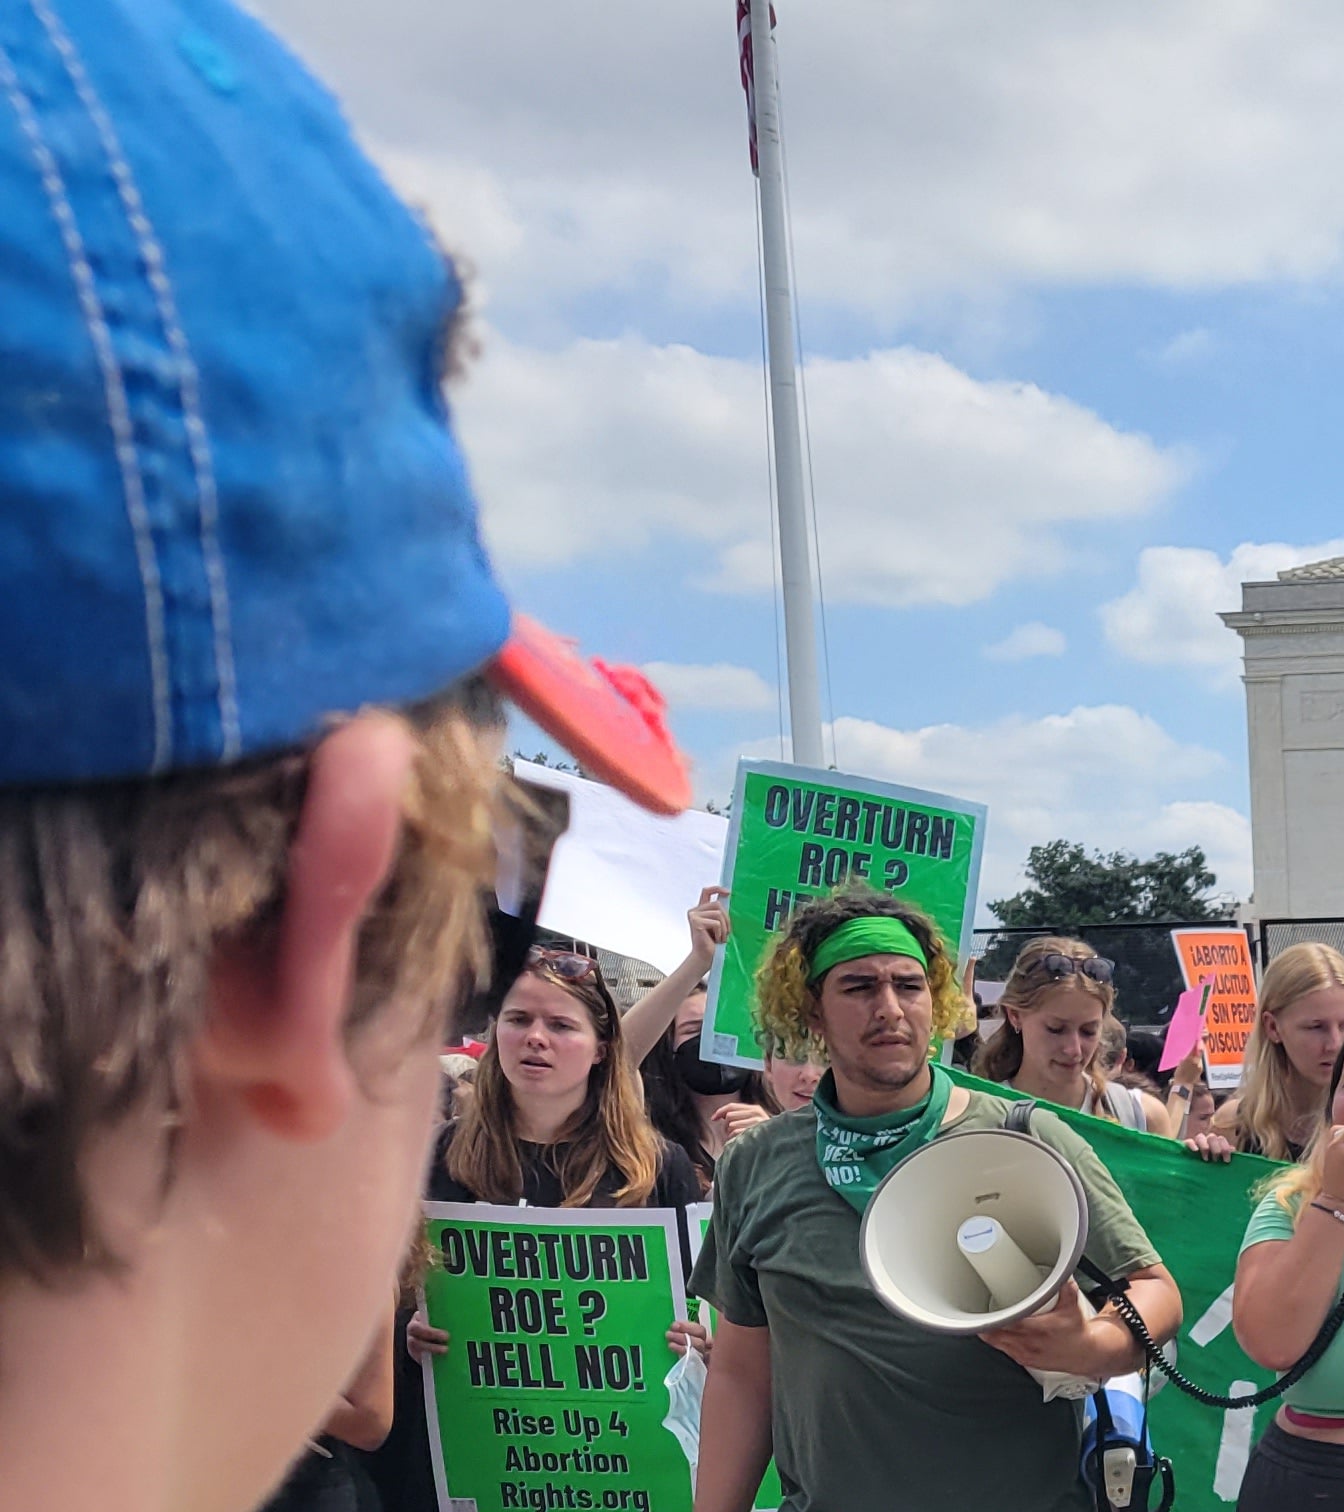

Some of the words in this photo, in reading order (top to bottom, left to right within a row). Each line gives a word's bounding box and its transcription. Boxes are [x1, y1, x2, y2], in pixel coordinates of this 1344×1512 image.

[764, 785, 957, 861] OVERTURN
[825, 1165, 862, 1187] NO!
[440, 1227, 651, 1283] OVERTURN
[489, 1286, 571, 1337] ROE
[577, 1289, 610, 1339] ?
[466, 1340, 566, 1392] HELL
[575, 1343, 648, 1394] NO!
[492, 1408, 557, 1438] Rise
[562, 1408, 601, 1442] Up
[608, 1410, 629, 1438] 4
[504, 1446, 629, 1474] Abortion
